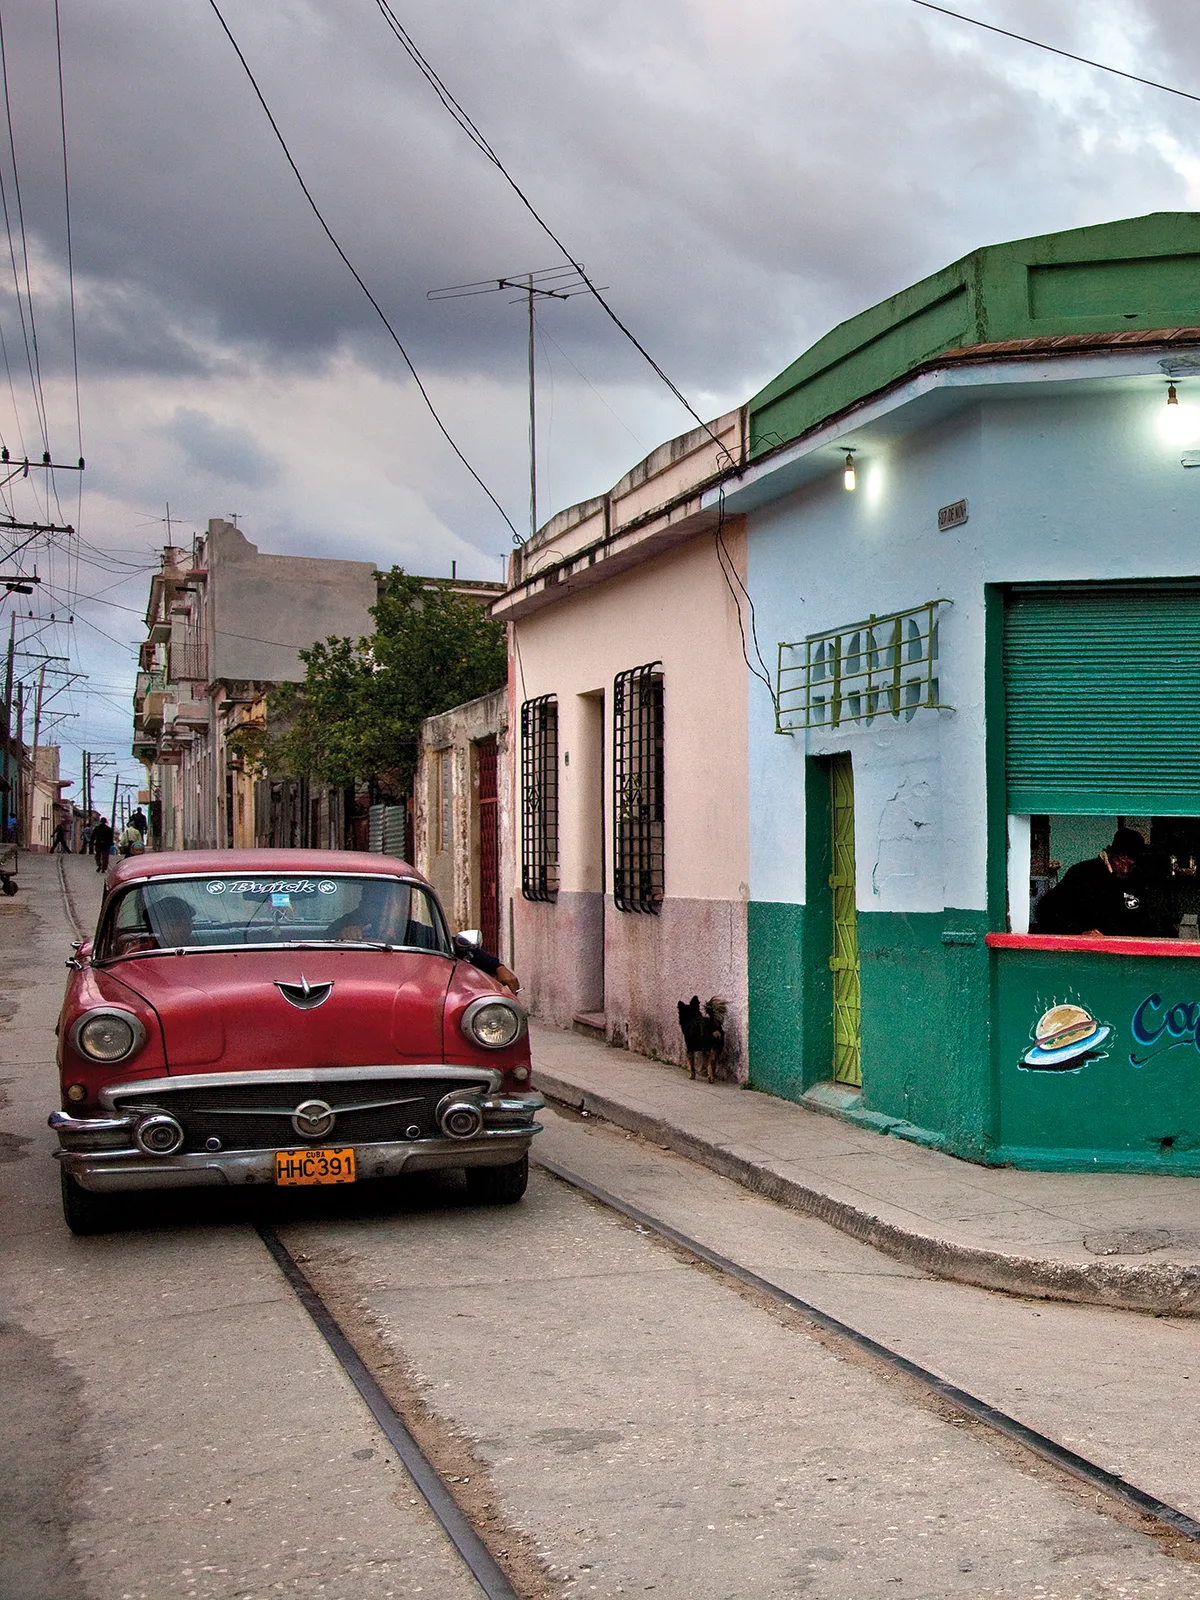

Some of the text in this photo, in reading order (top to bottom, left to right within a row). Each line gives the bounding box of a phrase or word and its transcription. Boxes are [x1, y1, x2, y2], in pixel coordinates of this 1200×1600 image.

[228, 880, 316, 894] Buick
[306, 1151, 326, 1159] CUBA
[278, 1156, 352, 1179] HHC391
